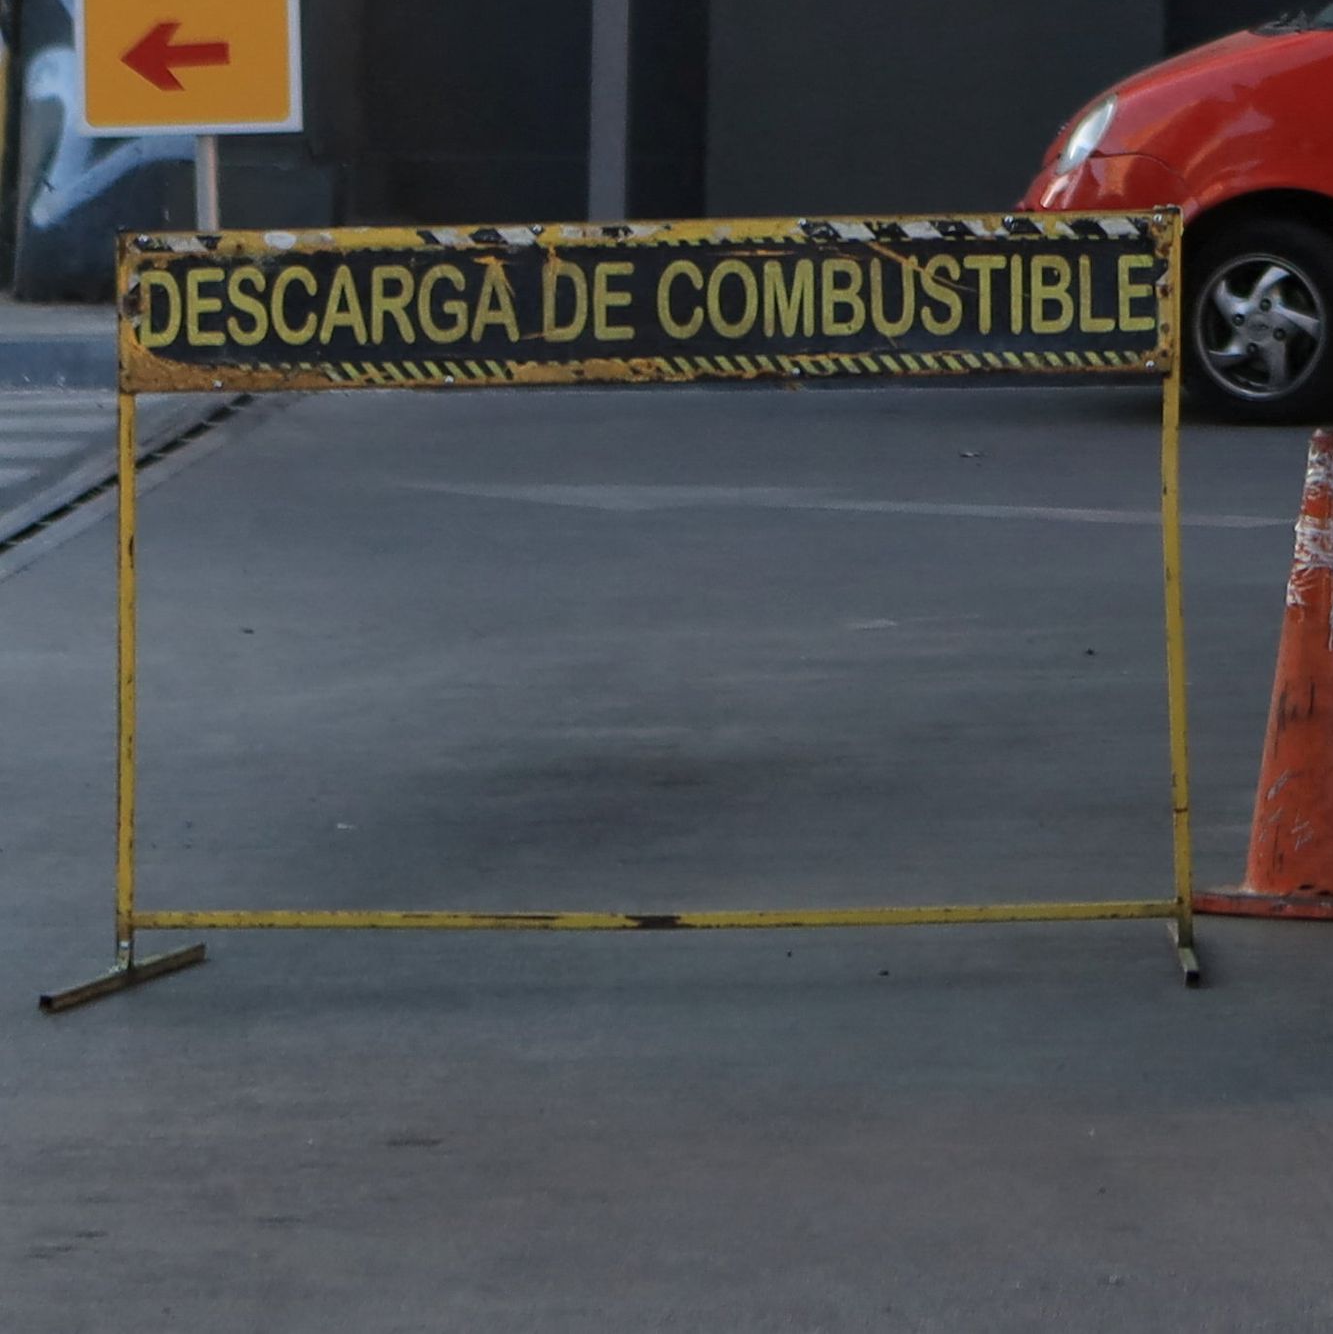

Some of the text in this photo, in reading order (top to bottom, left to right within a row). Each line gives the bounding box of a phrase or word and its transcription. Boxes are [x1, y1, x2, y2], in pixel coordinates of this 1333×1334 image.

[139, 253, 1156, 349] DESCARGA DE COMBUSTIBLE
